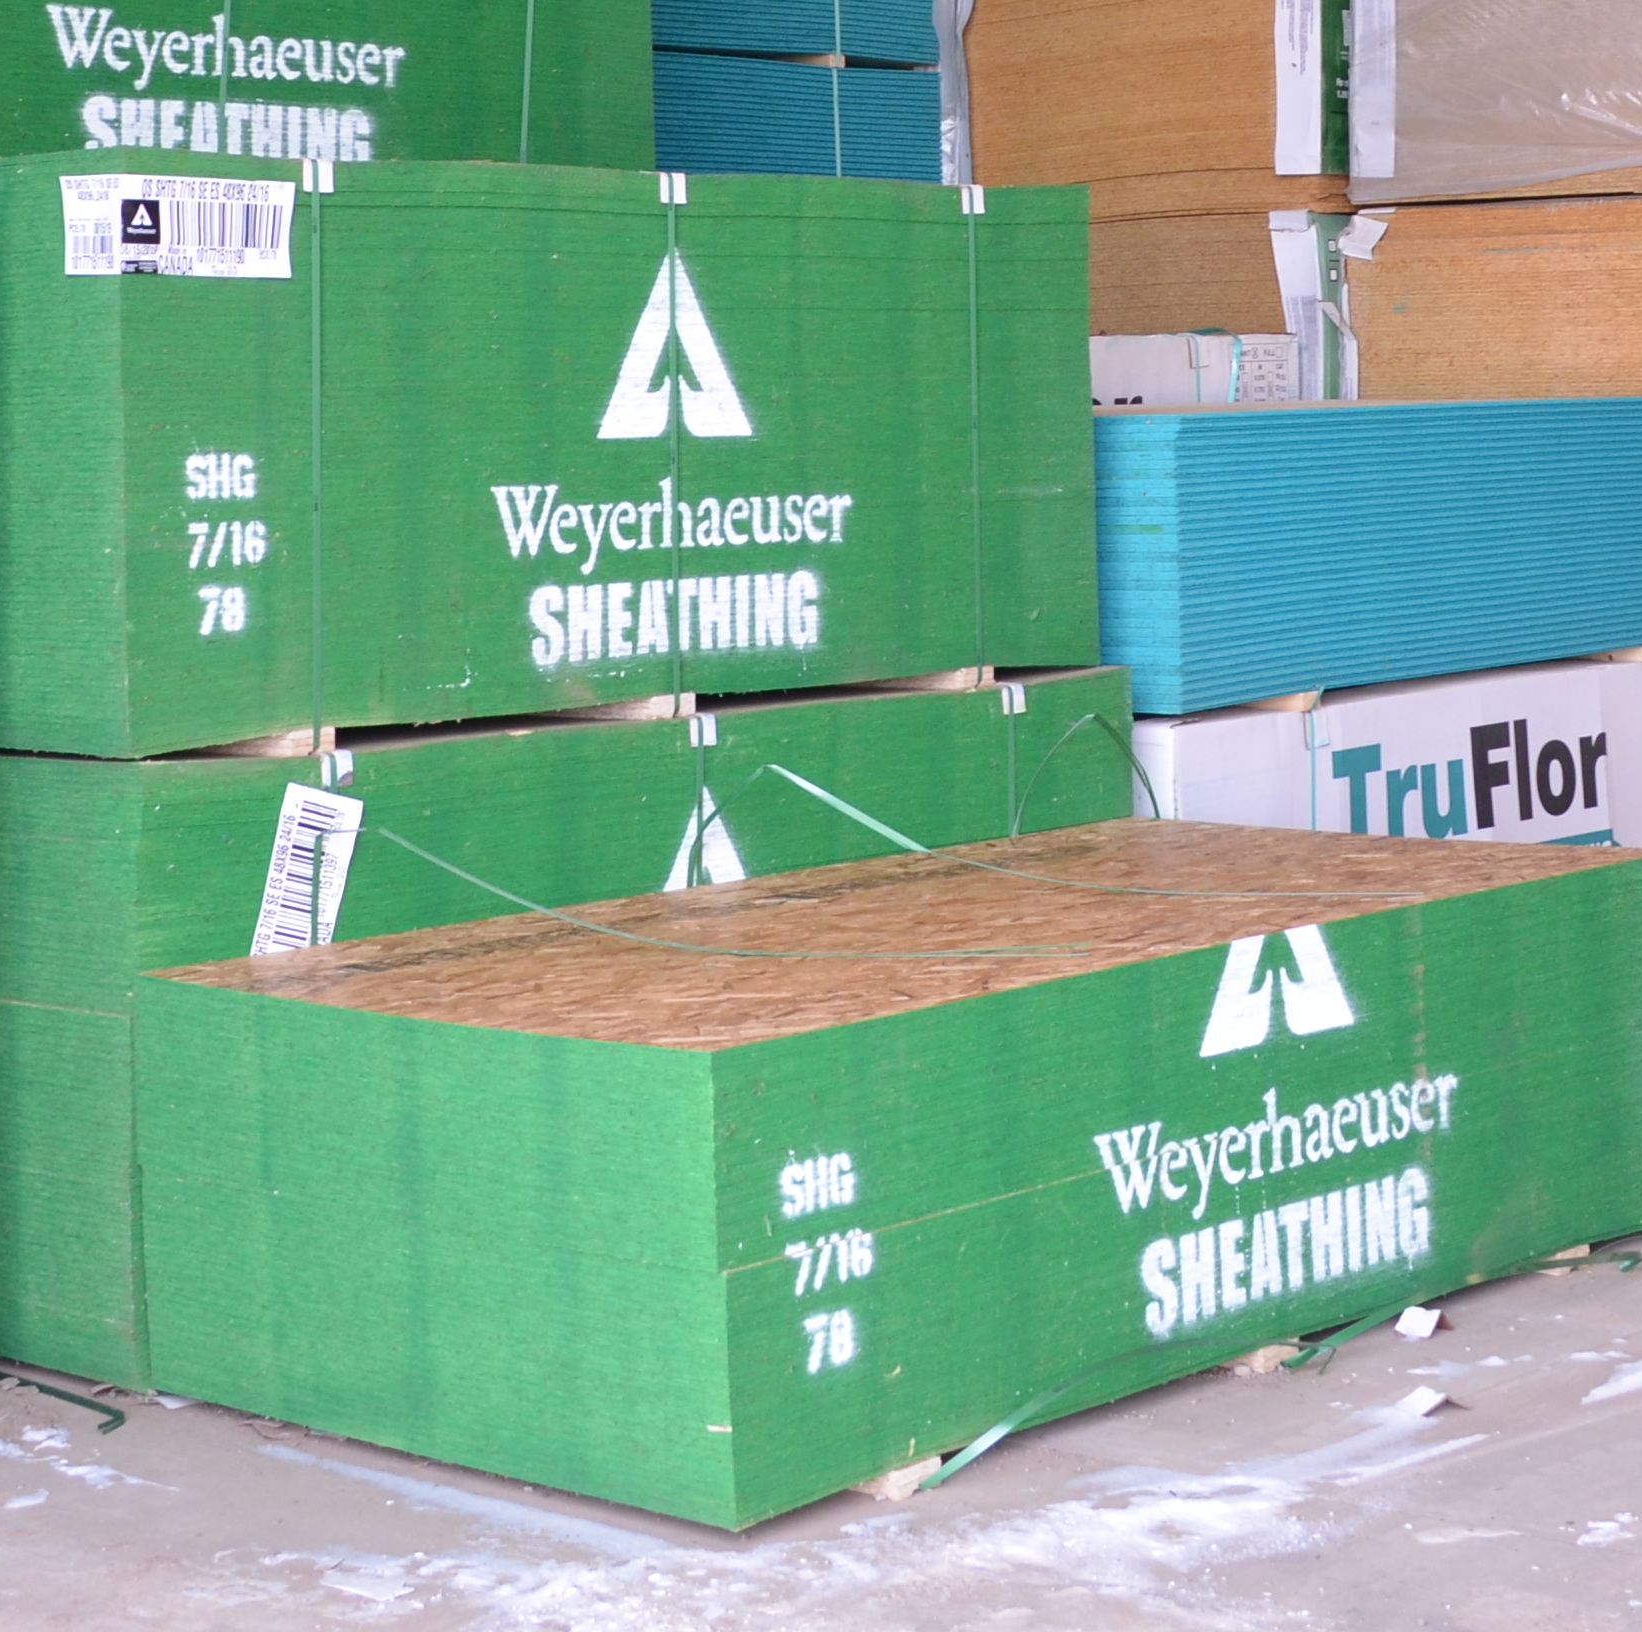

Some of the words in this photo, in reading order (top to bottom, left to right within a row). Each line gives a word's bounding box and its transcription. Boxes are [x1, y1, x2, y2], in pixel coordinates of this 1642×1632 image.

[46, 4, 405, 90] Weyerhaeuser
[82, 95, 372, 161] SHEATHING
[157, 255, 193, 276] CANADA
[186, 453, 256, 499] SHG
[188, 521, 266, 568] 7/16
[491, 477, 852, 575] Weyerhaeuser
[198, 585, 245, 635] 78
[529, 570, 820, 668] SHEATHING
[1332, 718, 1608, 840] TruFlor
[273, 844, 290, 875] 48X96
[279, 814, 296, 843] 24/16
[266, 892, 280, 908] SE
[269, 876, 283, 891] ES
[260, 909, 277, 931] 7/16
[1094, 1074, 1458, 1219] Weyerhaeuser
[779, 1153, 856, 1218] SHG
[784, 1228, 874, 1296] 7/16
[1141, 1168, 1430, 1338] SHEATHING
[804, 1309, 855, 1373] 78
